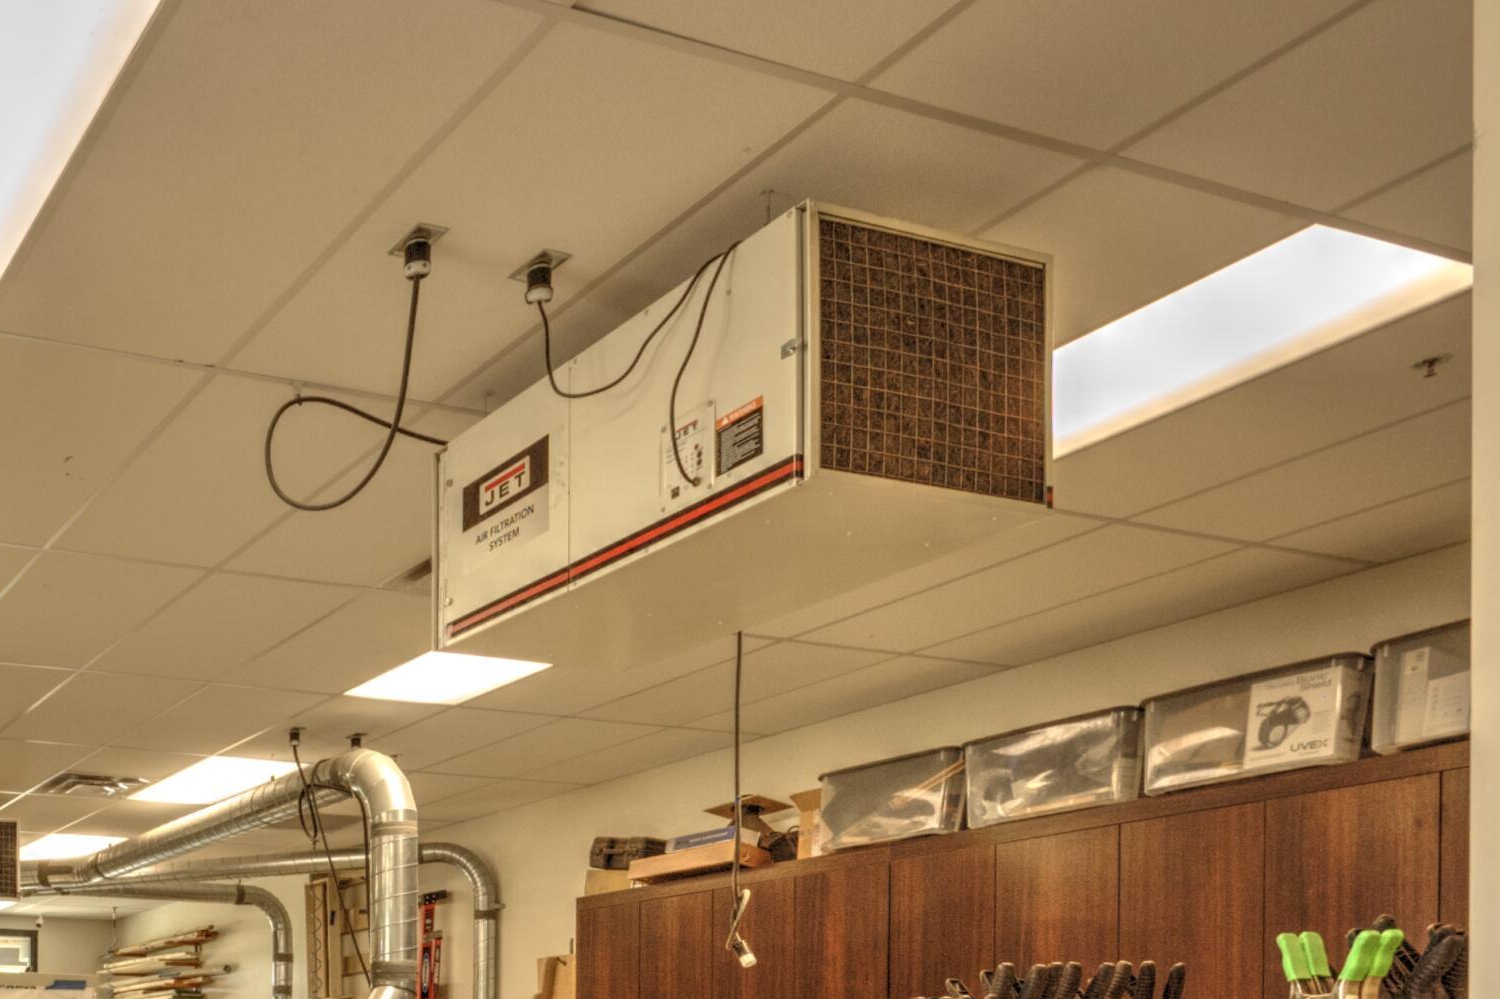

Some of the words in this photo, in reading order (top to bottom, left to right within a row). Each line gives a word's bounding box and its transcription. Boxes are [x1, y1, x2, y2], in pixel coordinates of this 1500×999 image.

[484, 470, 526, 507] JET
[476, 530, 489, 545] AIR
[490, 504, 535, 536] FILTRATION
[488, 526, 521, 552] SYSTEM
[1290, 739, 1328, 752] UVEX
